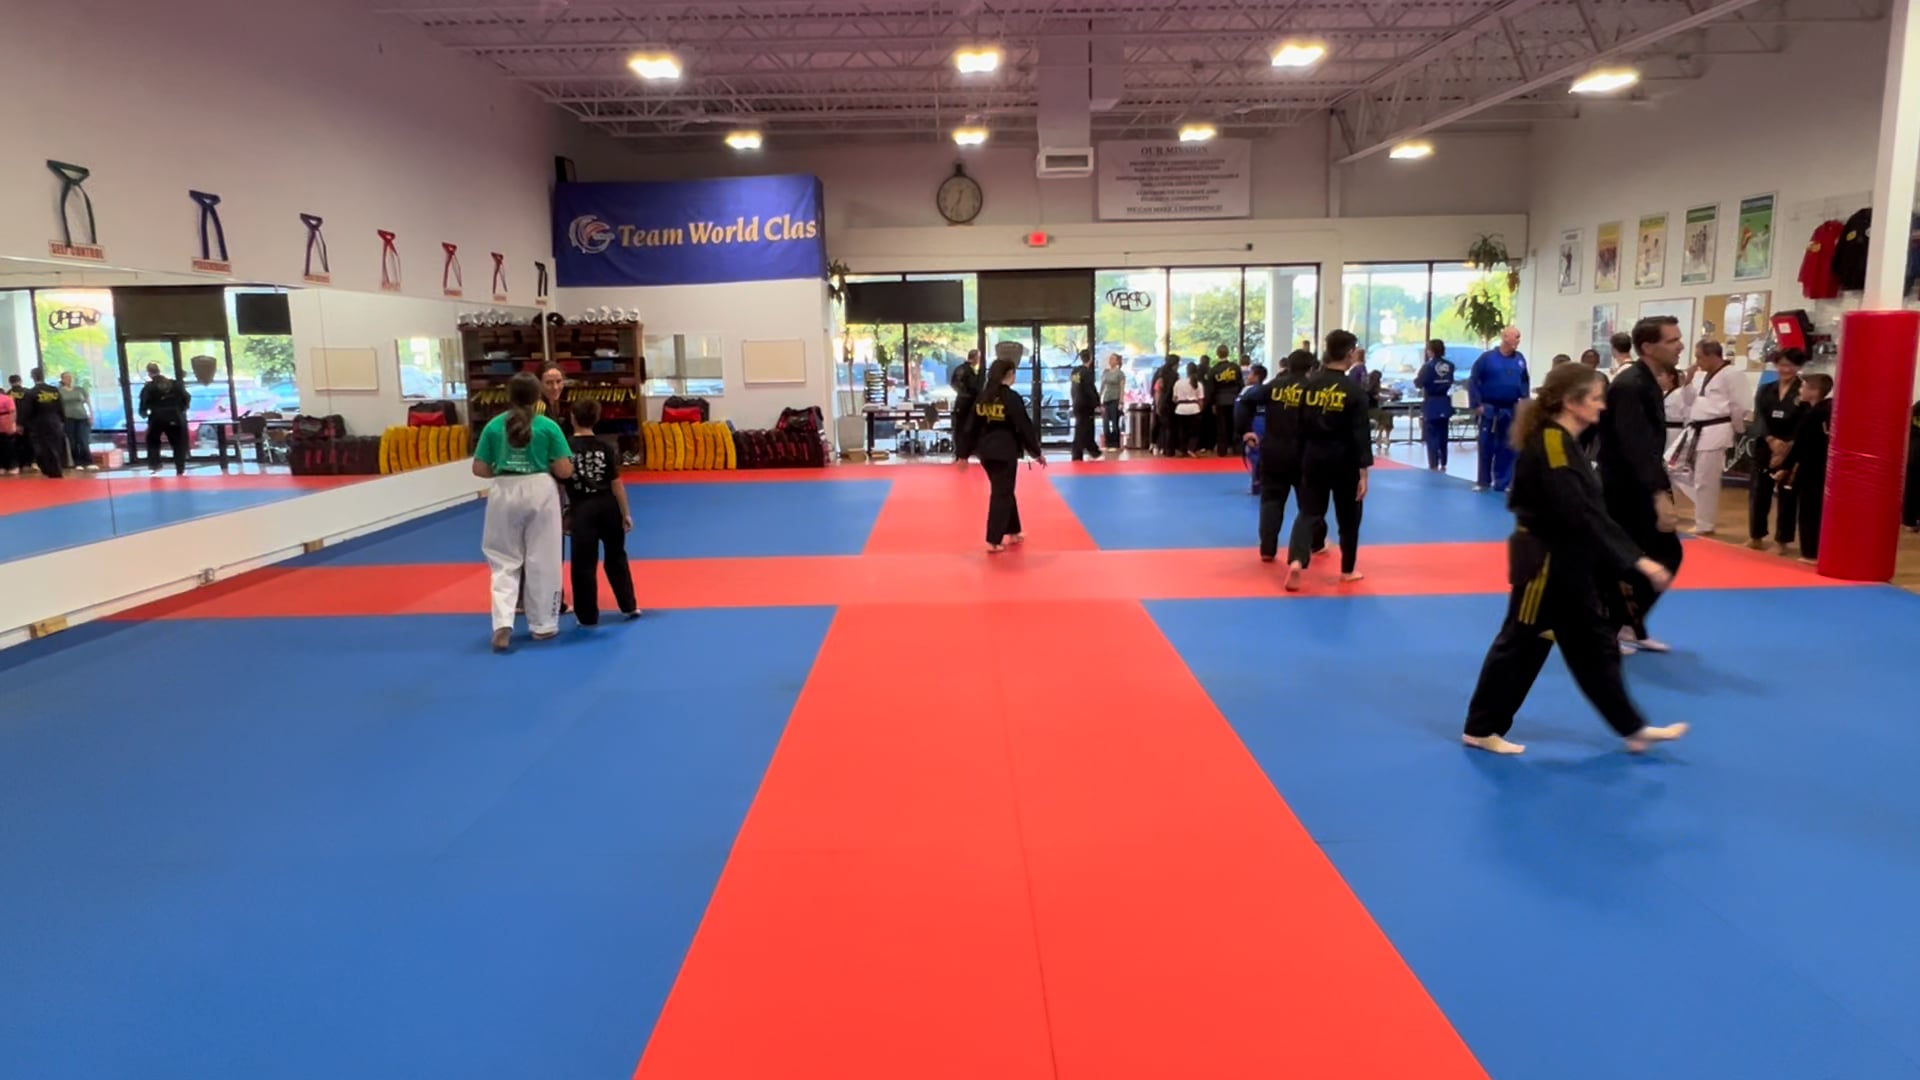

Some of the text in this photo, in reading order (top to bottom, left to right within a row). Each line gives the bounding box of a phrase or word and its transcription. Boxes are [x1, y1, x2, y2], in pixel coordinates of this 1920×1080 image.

[1141, 146, 1164, 155] OUR
[618, 214, 818, 247] Team World Clas
[49, 309, 100, 330] OPEN
